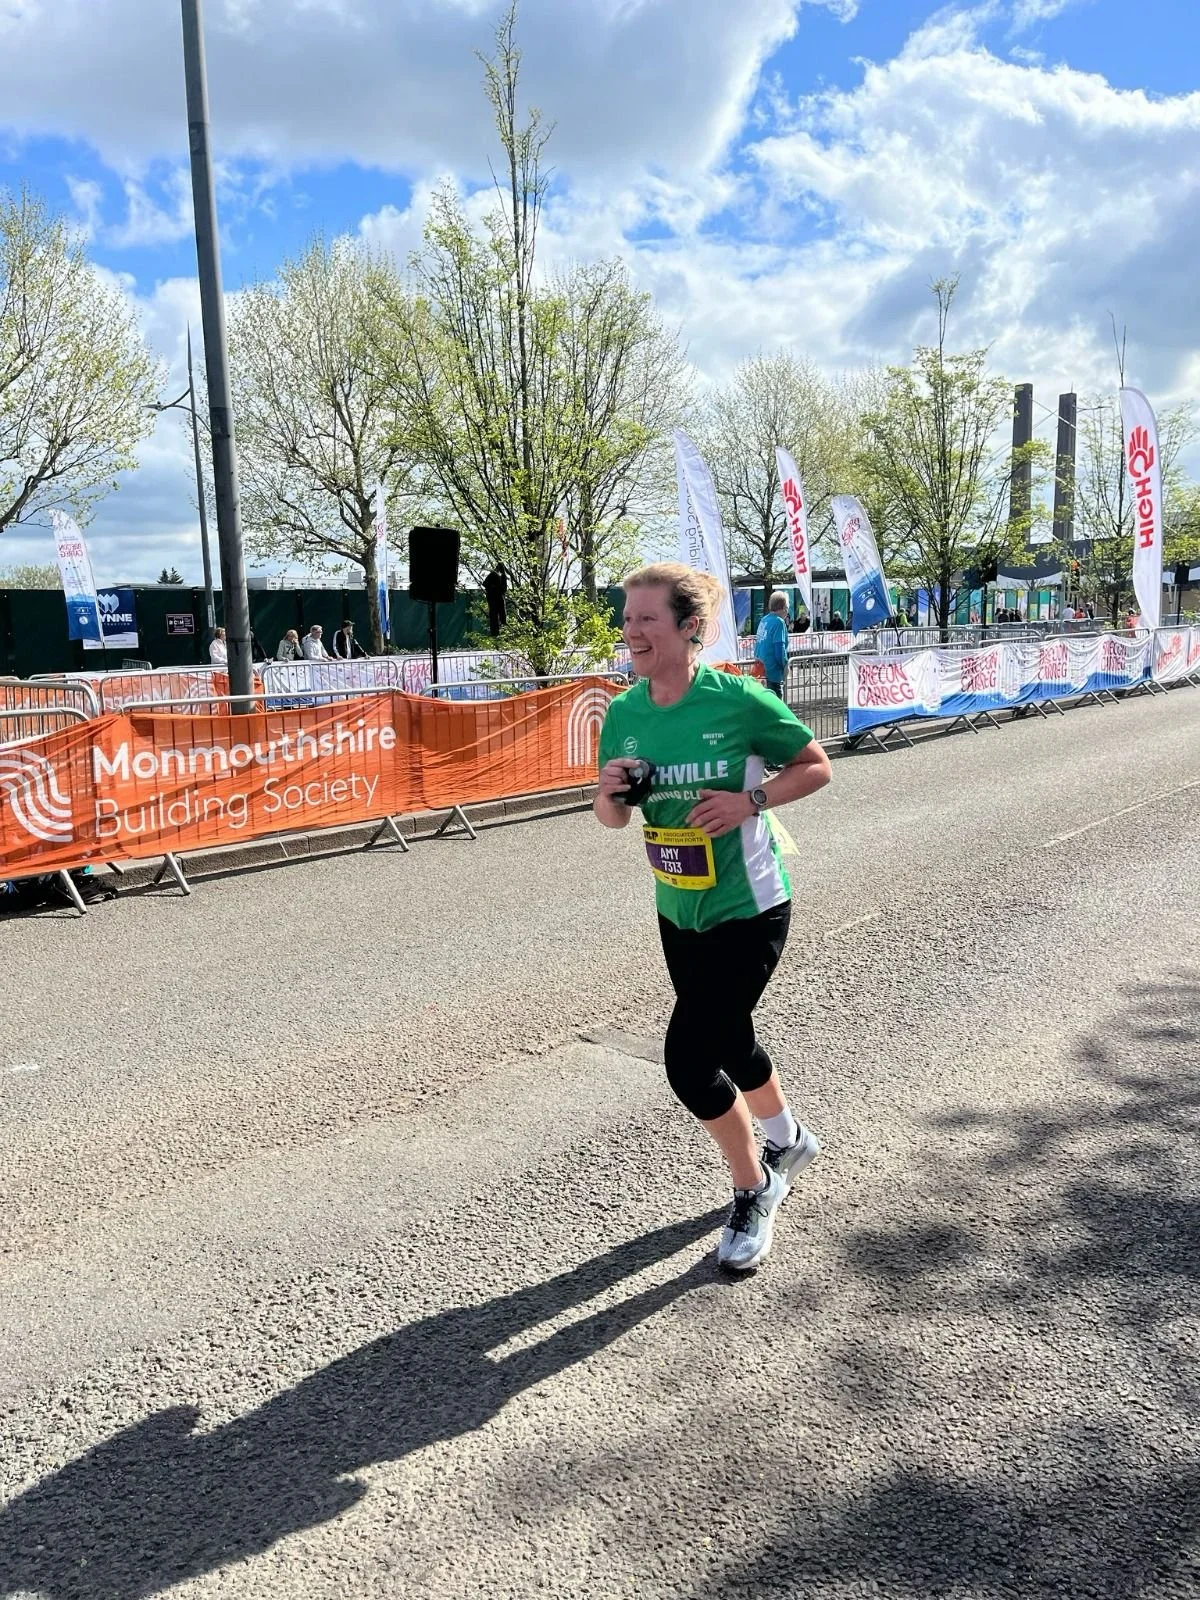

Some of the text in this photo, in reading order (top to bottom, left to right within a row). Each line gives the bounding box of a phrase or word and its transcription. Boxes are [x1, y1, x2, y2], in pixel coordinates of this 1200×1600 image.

[100, 613, 133, 623] YNNE
[858, 662, 909, 686] BRECON
[857, 682, 915, 708] CARREG
[93, 720, 397, 783] Monmouthshire
[94, 772, 380, 838] Building Society
[660, 847, 679, 860] AMY
[662, 860, 683, 873] 7313
